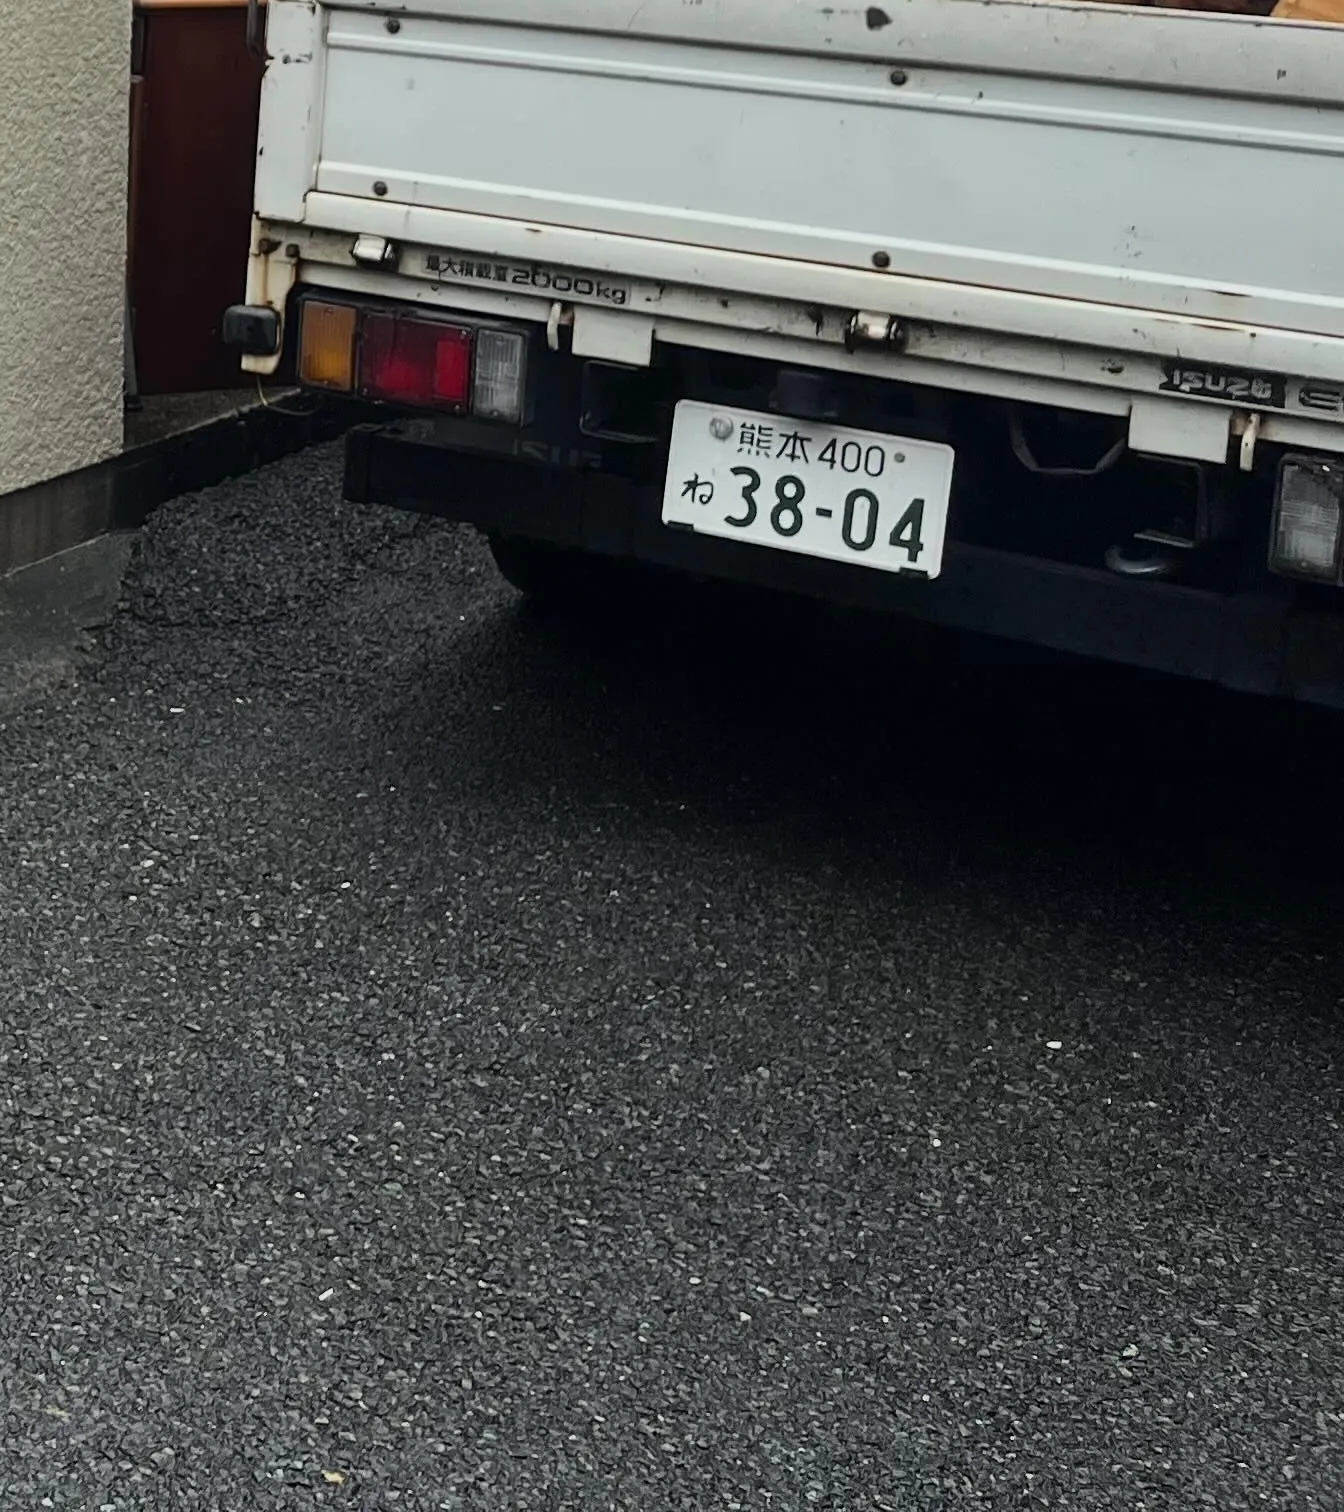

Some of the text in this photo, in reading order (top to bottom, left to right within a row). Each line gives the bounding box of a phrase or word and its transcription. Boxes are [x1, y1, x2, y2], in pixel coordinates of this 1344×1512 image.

[736, 421, 886, 477] 熊本 400
[680, 465, 926, 563] ね 38-04
